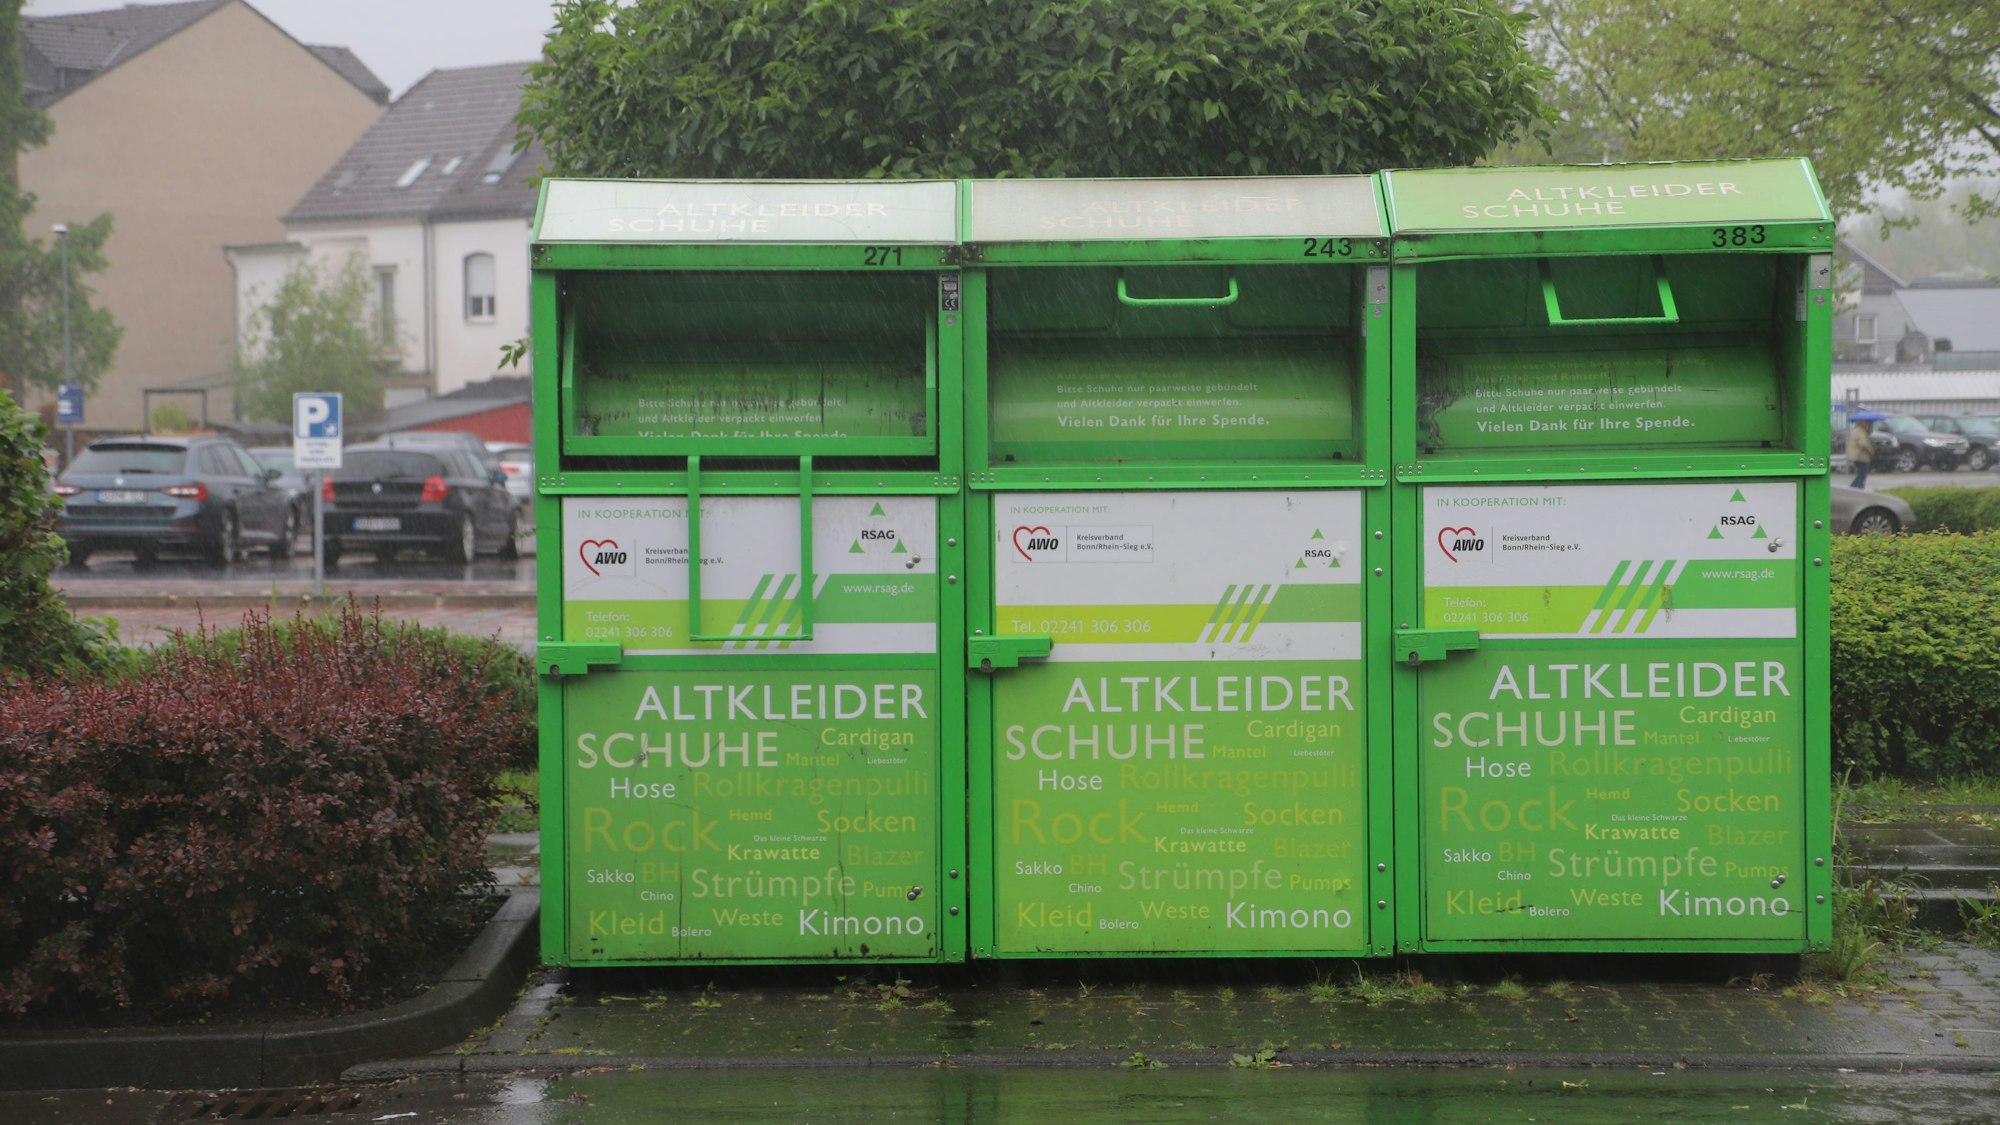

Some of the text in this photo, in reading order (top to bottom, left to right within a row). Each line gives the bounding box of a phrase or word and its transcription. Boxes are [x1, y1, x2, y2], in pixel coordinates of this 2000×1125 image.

[1507, 182, 1743, 201] ALTKLEIDER
[656, 203, 888, 218] ALTKLEIDER
[1084, 197, 1307, 215] ALTKLEIDER
[1463, 201, 1625, 219] SCHUHE
[608, 218, 769, 233] SCHUHE
[1040, 215, 1193, 229] SCHUHE
[1712, 225, 1767, 248] 383
[864, 247, 902, 266] 271
[1303, 237, 1353, 258] 243
[1057, 383, 1258, 394] Bitte Schuhe nur paarweise gebündelt
[1475, 388, 1501, 398] Bitte
[1506, 388, 1544, 397] Schuhe
[1570, 386, 1624, 397] paarweise
[1628, 384, 1682, 396] gebündelt
[639, 398, 665, 408] Bitte
[1057, 400, 1076, 409] und
[1080, 399, 1133, 408] Altkleider
[1137, 398, 1183, 409] verpackt
[1476, 405, 1496, 414] und
[1500, 403, 1554, 413] Altkleider
[1558, 402, 1605, 413] verpackt
[299, 398, 330, 437] P
[639, 414, 658, 423] und
[720, 414, 766, 425] verpackt
[1058, 413, 1270, 429] Vielen Dank für Ihre Spende.
[1477, 415, 1696, 432] Vielen Dank für Ihre Spende.
[1010, 506, 1021, 514] IN
[1023, 505, 1090, 514] KOOPERATION
[1437, 497, 1567, 507] IN KOOPERATION MIT:
[578, 509, 681, 519] IN KOOPERATION
[1720, 515, 1756, 526] RSAG
[861, 529, 895, 540] RSAG
[1502, 534, 1550, 542] Kreisverband
[645, 547, 689, 555] Kreisverban
[1027, 538, 1059, 551] AWO
[1077, 543, 1139, 552] Bonn/Rhein-Sieg
[1305, 549, 1332, 558] RSAG
[1452, 538, 1485, 552] AWO
[1502, 543, 1581, 553] Bonn/Rhein-Sieg e.V.
[595, 551, 627, 565] AWO
[645, 557, 709, 566] Bonn/Rheineg
[1702, 567, 1775, 583] www.rsag.de
[843, 582, 915, 596] www.rsag.de
[1444, 598, 1486, 609] Telefon:
[586, 611, 630, 622] Telefon:
[1443, 612, 1529, 623] 02241 306 306
[586, 626, 673, 638] 02241 306 306
[1040, 619, 1085, 633] 02241
[1091, 619, 1119, 633] 306
[1124, 619, 1152, 633] 306
[1489, 661, 1791, 700] ALTKLEIDER
[634, 684, 928, 720] ALTKLEIDER
[1062, 675, 1355, 713] ALTKLEIDER
[1680, 705, 1777, 729] Cardigan
[1247, 719, 1341, 743] Cardigan
[1432, 710, 1636, 748] SCHUHE
[1644, 731, 1700, 745] Mantel
[820, 727, 914, 751] Cardigan
[1006, 723, 1205, 760] SCHUHE
[576, 732, 779, 768] SCHUHE
[1212, 744, 1267, 759] Mantel
[786, 752, 840, 767] Mantel
[1465, 756, 1532, 778] Hose
[1549, 748, 1792, 783] Rollkragenpulli
[610, 776, 676, 799] Hose
[693, 769, 930, 804] Rollkragenpulli
[1039, 769, 1103, 791] Hose
[1119, 762, 1356, 796] Rollkragenpulli
[1586, 788, 1631, 801] Hemd
[1676, 788, 1781, 813] Socken
[729, 809, 773, 823] Hemd
[1156, 801, 1199, 814] Hemd
[1243, 801, 1344, 826] Socken
[1441, 785, 1579, 832] Rock
[816, 809, 917, 834] Socken
[1012, 798, 1148, 845] Rock
[1611, 814, 1688, 822] Das kleine Schwarze
[583, 807, 723, 854] Rock
[753, 834, 827, 842] Das kleine Schwarze
[1180, 826, 1254, 835] Das kleine Schwarze
[1584, 823, 1681, 841] Krawatte
[1708, 824, 1790, 847] Blazer
[728, 844, 820, 862] Krawatte
[1154, 836, 1247, 854] Krawatte
[1273, 837, 1351, 859] Blazer
[1502, 841, 1536, 863] BH
[847, 845, 924, 866] Blazer
[1070, 854, 1107, 875] BH
[1443, 848, 1492, 864] Sakko
[642, 862, 681, 884] BH
[1015, 861, 1063, 876] Sakko
[1548, 847, 1718, 886] Strümpfe
[1725, 861, 1790, 882] Pumps
[587, 868, 635, 884] Sakko
[1119, 860, 1283, 899] Strümpfe
[1289, 874, 1352, 895] Pumps
[1497, 870, 1532, 882] Chino
[691, 867, 857, 906] Strümpfe
[1068, 882, 1102, 894] Chino
[640, 890, 675, 902] Chino
[1446, 889, 1522, 916] Kleid
[1570, 888, 1643, 907] Weste
[1658, 888, 1791, 917] Kimono
[712, 908, 783, 927] Weste
[1017, 902, 1092, 928] Kleid
[1140, 901, 1211, 920] Weste
[1225, 901, 1352, 929] Kimono
[1529, 906, 1570, 918] Bolero
[588, 911, 664, 936] Kleid
[799, 909, 925, 936] Kimono
[1099, 918, 1139, 930] Bolero
[671, 926, 712, 938] Bolero
